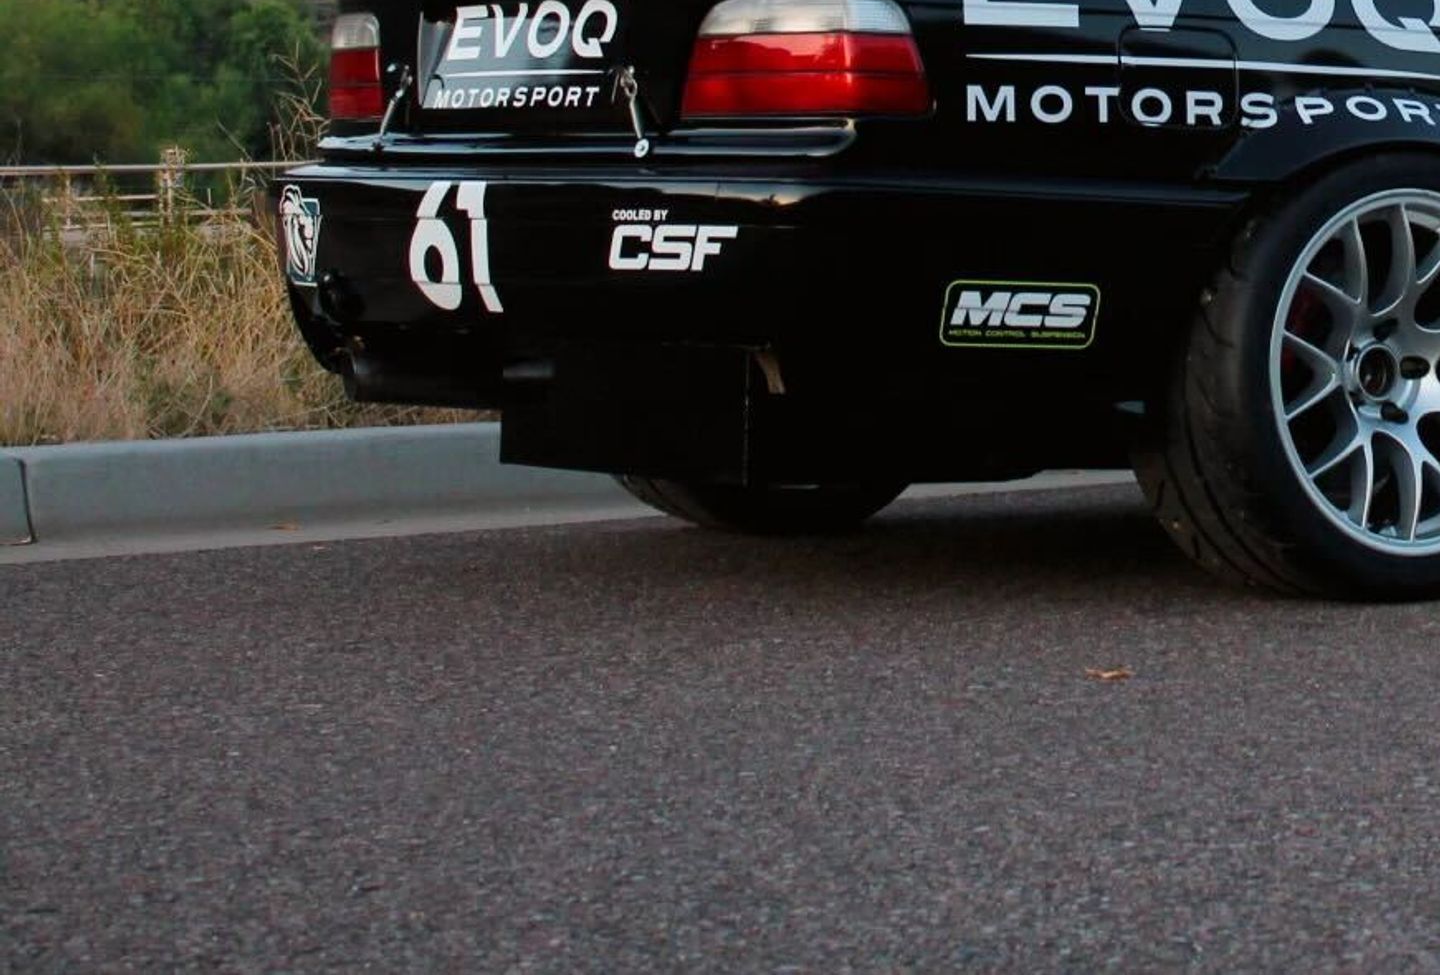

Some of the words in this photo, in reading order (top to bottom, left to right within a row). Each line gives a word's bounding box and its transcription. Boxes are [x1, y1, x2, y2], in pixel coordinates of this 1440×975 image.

[433, 85, 600, 110] MOTORSPORT
[612, 209, 652, 221] COOLED
[653, 209, 669, 221] BY
[409, 180, 503, 313] 61
[609, 225, 738, 270] CSF
[950, 290, 1092, 328] MCS
